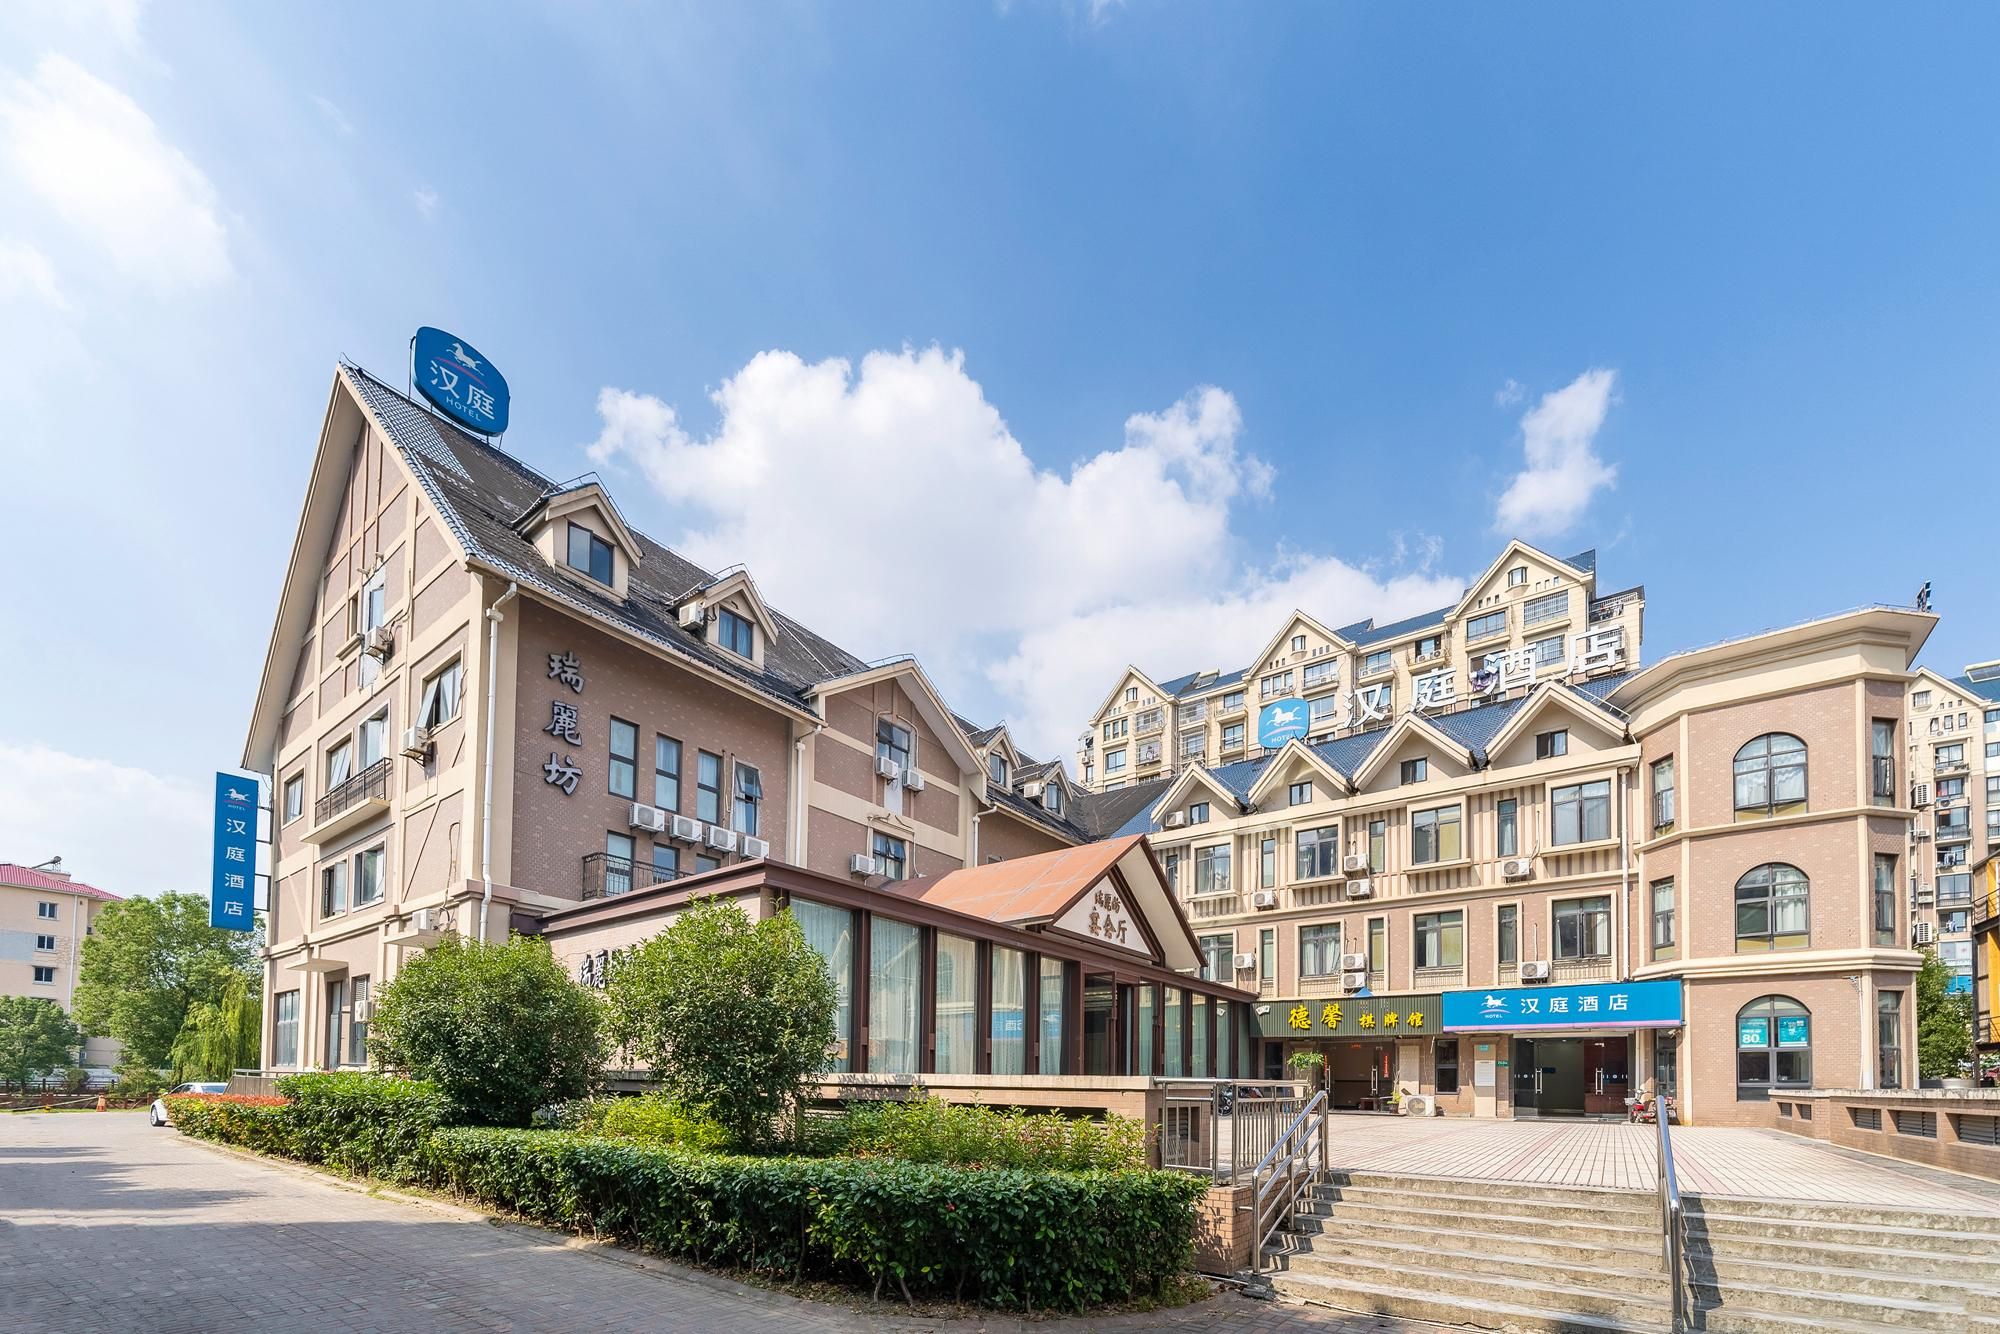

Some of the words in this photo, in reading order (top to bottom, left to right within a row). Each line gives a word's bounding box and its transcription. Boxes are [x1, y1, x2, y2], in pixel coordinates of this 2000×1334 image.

[430, 360, 495, 420] 汉庭
[446, 396, 481, 422] HOTEL
[1343, 624, 1624, 729] 汉庭酒店
[543, 651, 585, 795] 瑞麗坊
[224, 818, 246, 916] 汉庭酒店
[1089, 906, 1127, 944] 宴会厅
[1520, 994, 1629, 1014] 汉庭酒店
